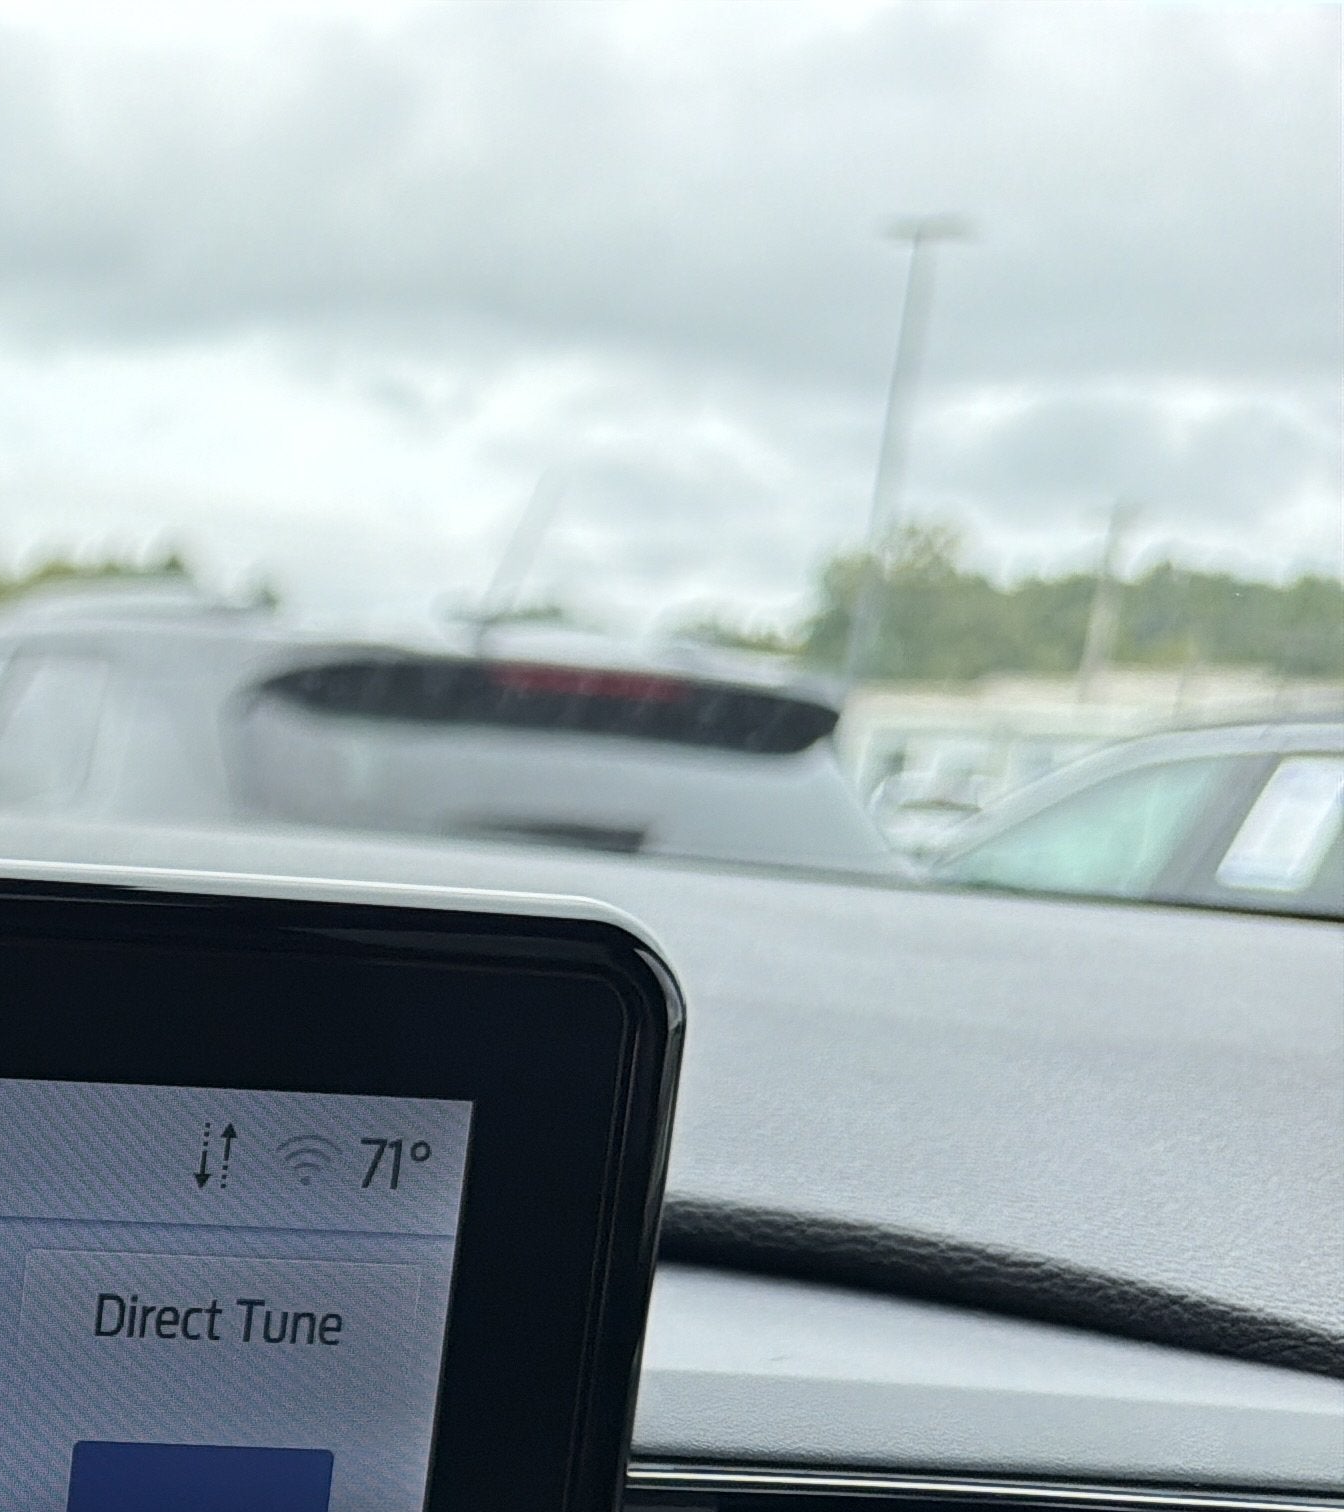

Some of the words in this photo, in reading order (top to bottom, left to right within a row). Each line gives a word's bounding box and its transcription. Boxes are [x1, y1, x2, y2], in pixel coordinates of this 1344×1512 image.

[359, 1138, 432, 1191] 71°
[94, 1292, 223, 1342] Direct
[236, 1298, 343, 1346] Tune
